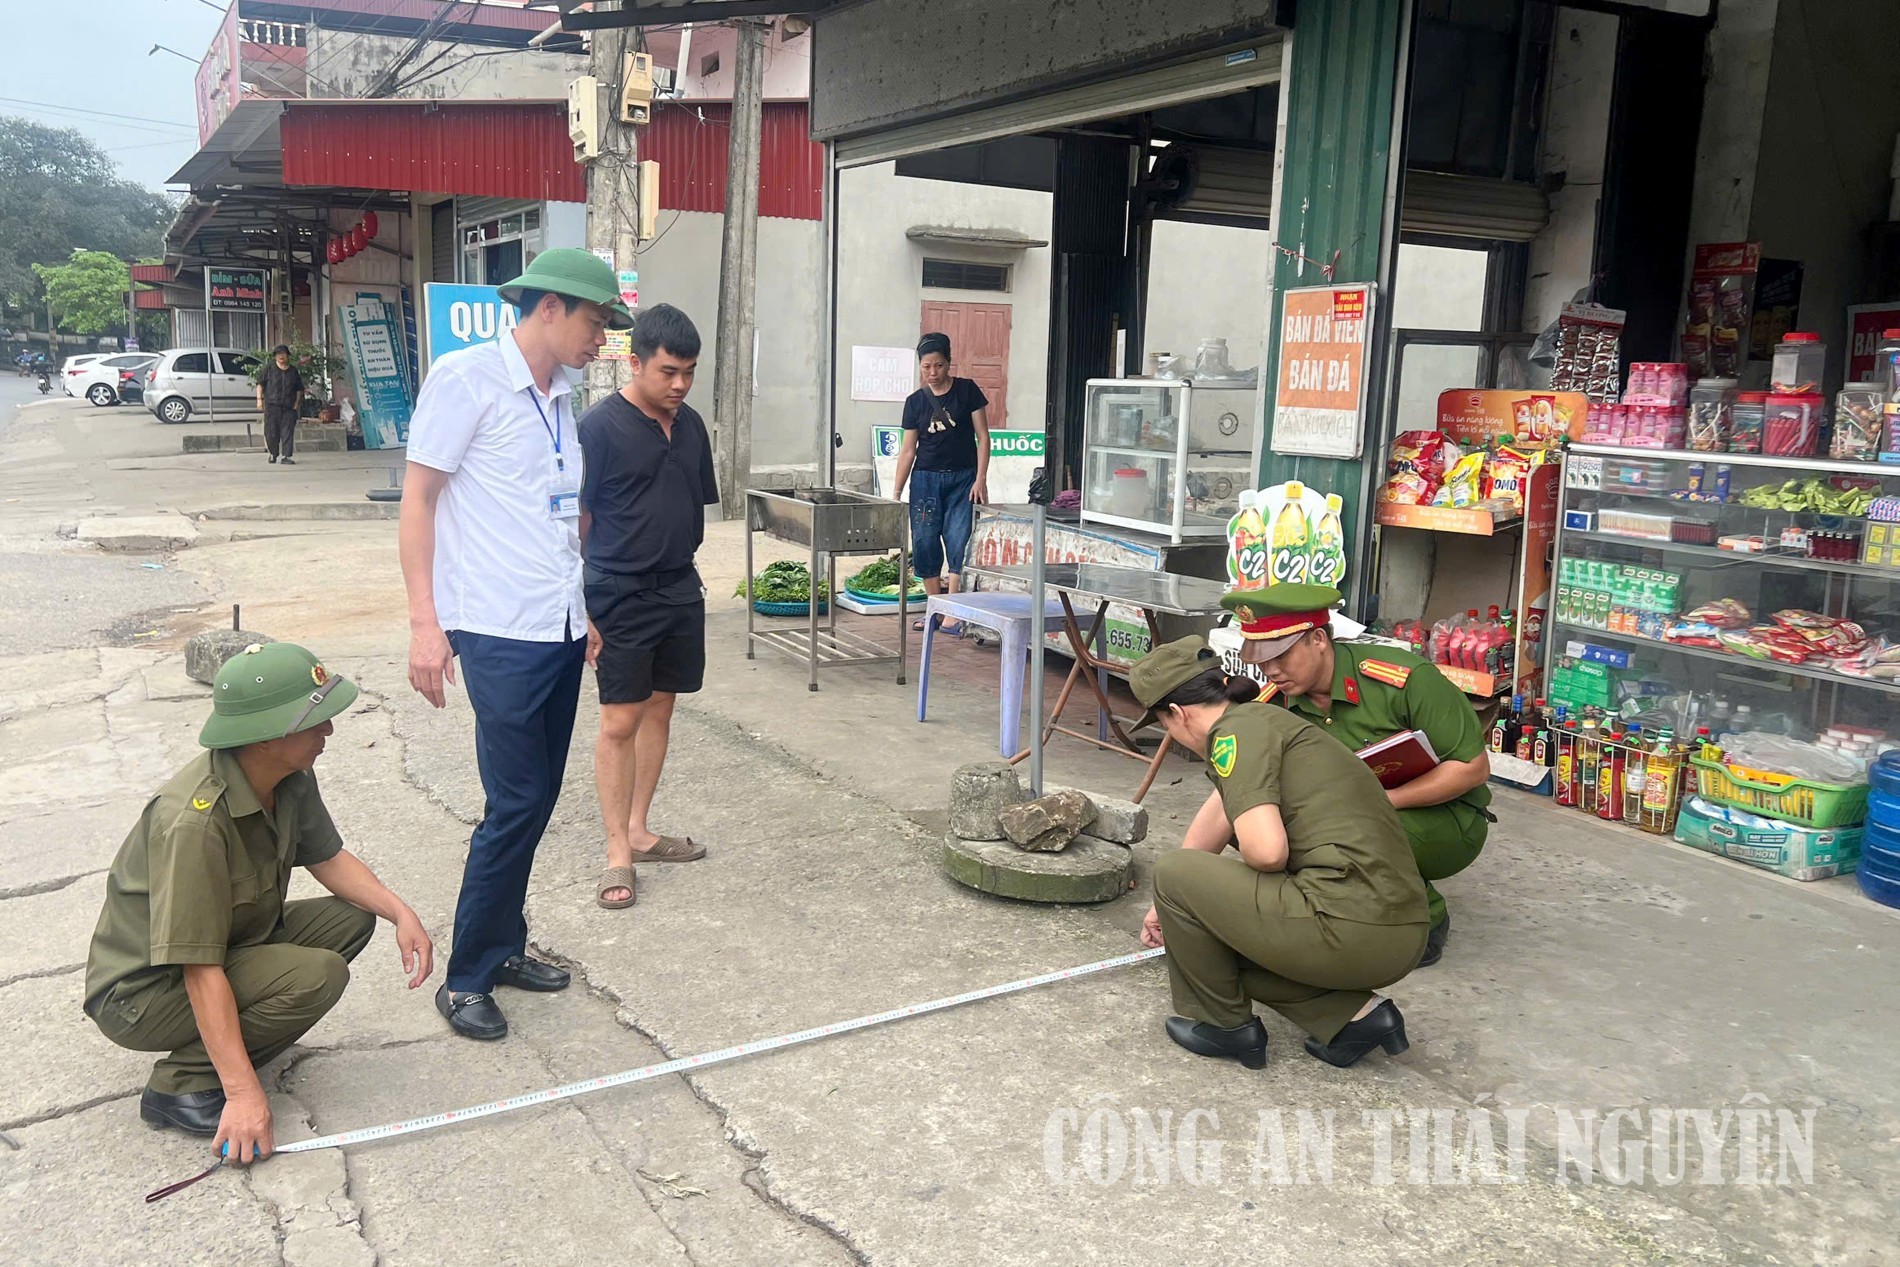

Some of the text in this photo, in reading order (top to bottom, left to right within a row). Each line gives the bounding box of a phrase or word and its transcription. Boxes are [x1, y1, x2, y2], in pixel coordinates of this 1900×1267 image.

[1285, 310, 1312, 344] BÁN
[1313, 309, 1331, 344] ĐÁ
[1288, 353, 1350, 392] BÁN ĐÁ
[988, 433, 1043, 452] HUỐC
[1494, 479, 1518, 492] OMO
[1239, 548, 1267, 579] C2
[1272, 548, 1306, 583] C2
[1310, 549, 1337, 583] C2
[1713, 825, 1733, 836] MILO
